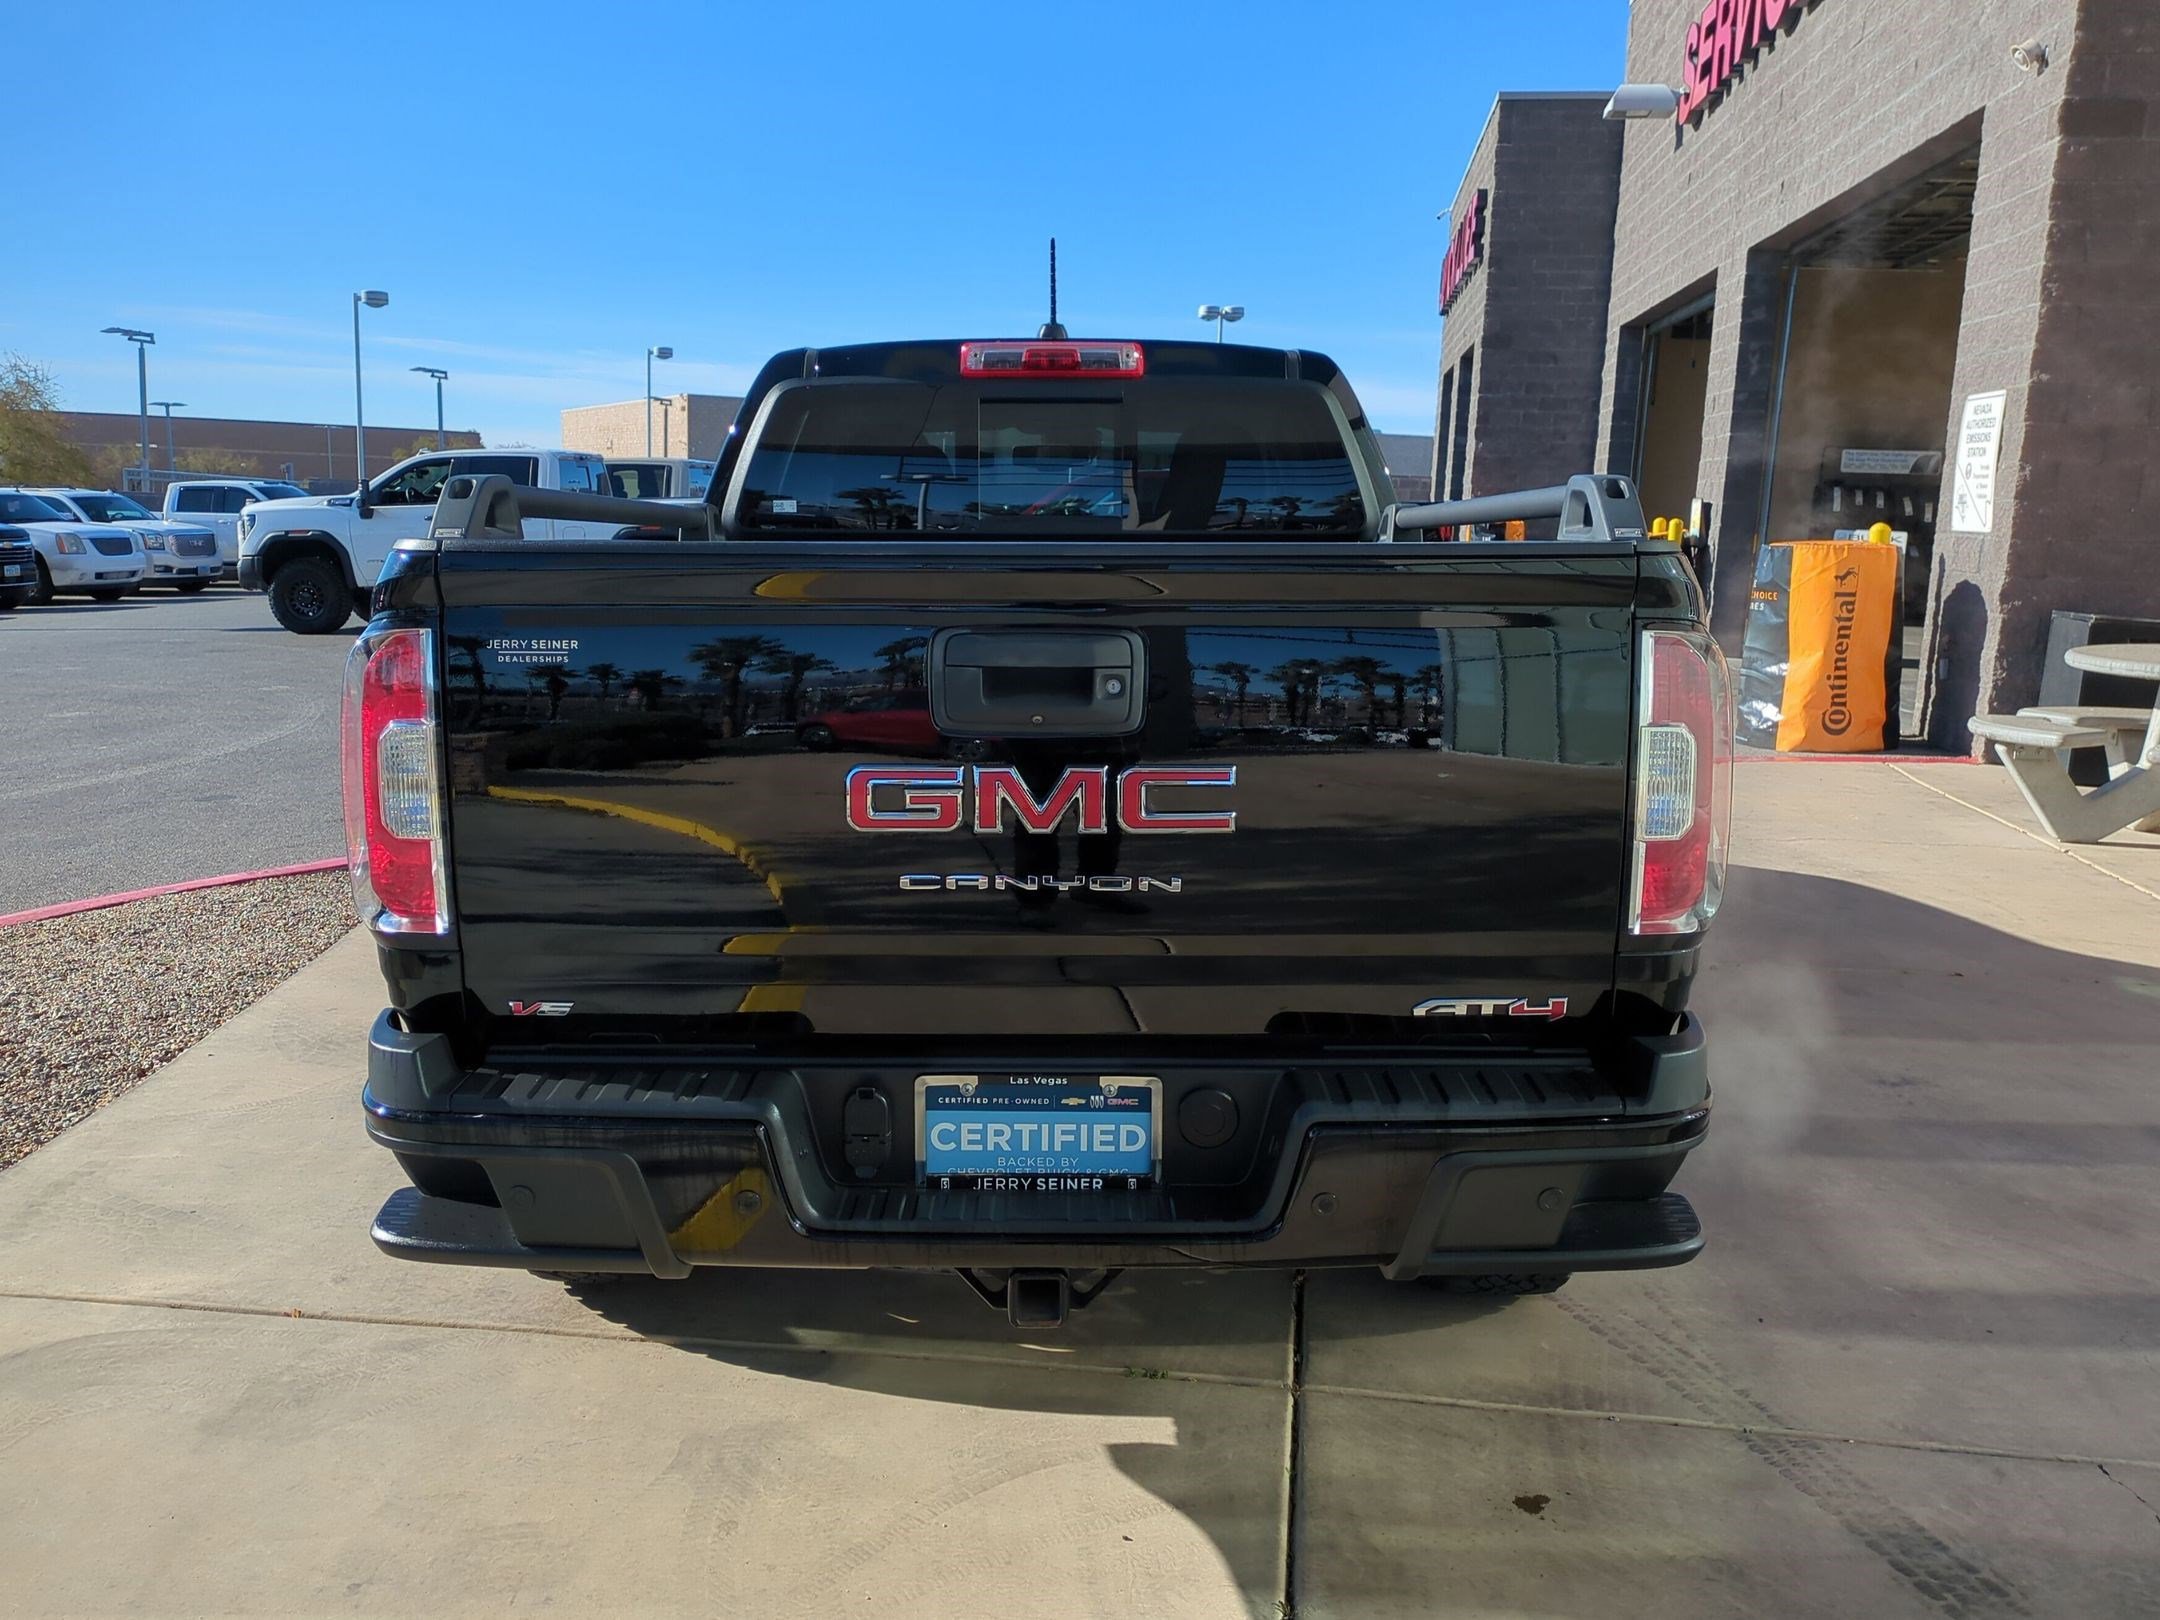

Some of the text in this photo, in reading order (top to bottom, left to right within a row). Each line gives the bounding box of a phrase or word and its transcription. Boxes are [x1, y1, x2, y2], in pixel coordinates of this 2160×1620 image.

[1677, 0, 1798, 126] SERVI
[486, 639, 579, 650] JERRY SEINER
[497, 655, 569, 663] DEALERSHIPS
[1822, 590, 1858, 737] Continental
[845, 764, 1237, 834] GMC
[899, 874, 1182, 893] CANYON
[508, 1001, 575, 1016] V6
[1412, 997, 1569, 1022] AT4
[1010, 1076, 1068, 1086] Las Vegas
[992, 1097, 1050, 1105] PRE-OWNED
[1107, 1098, 1139, 1106] GMC
[930, 1122, 1147, 1153] CERTIFIED
[997, 1157, 1079, 1167] BACKED BY
[972, 1177, 1032, 1190] JERRY
[1036, 1178, 1103, 1190] SEINER
